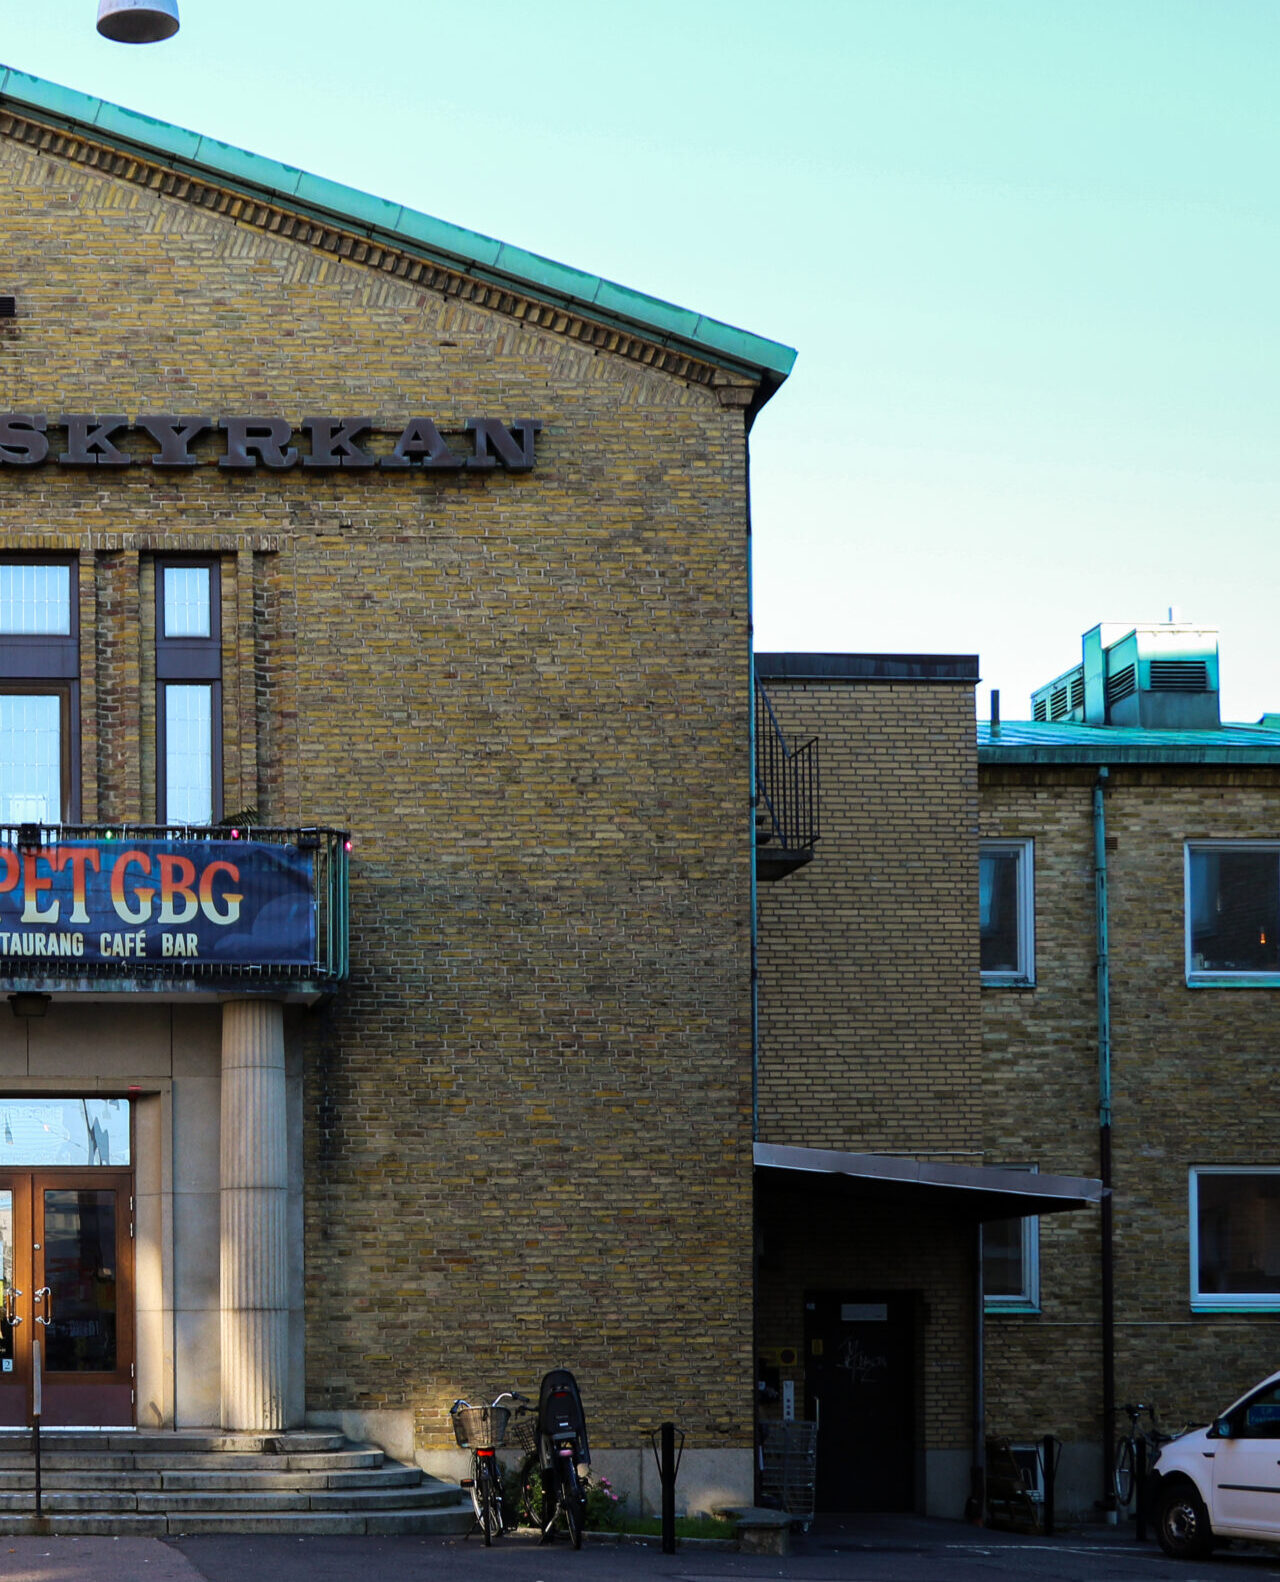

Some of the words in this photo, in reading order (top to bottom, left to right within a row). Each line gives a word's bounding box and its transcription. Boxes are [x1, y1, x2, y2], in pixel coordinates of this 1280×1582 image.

[110, 850, 244, 925] GBG
[99, 929, 147, 957] CAFÉ
[161, 932, 199, 957] BAR
